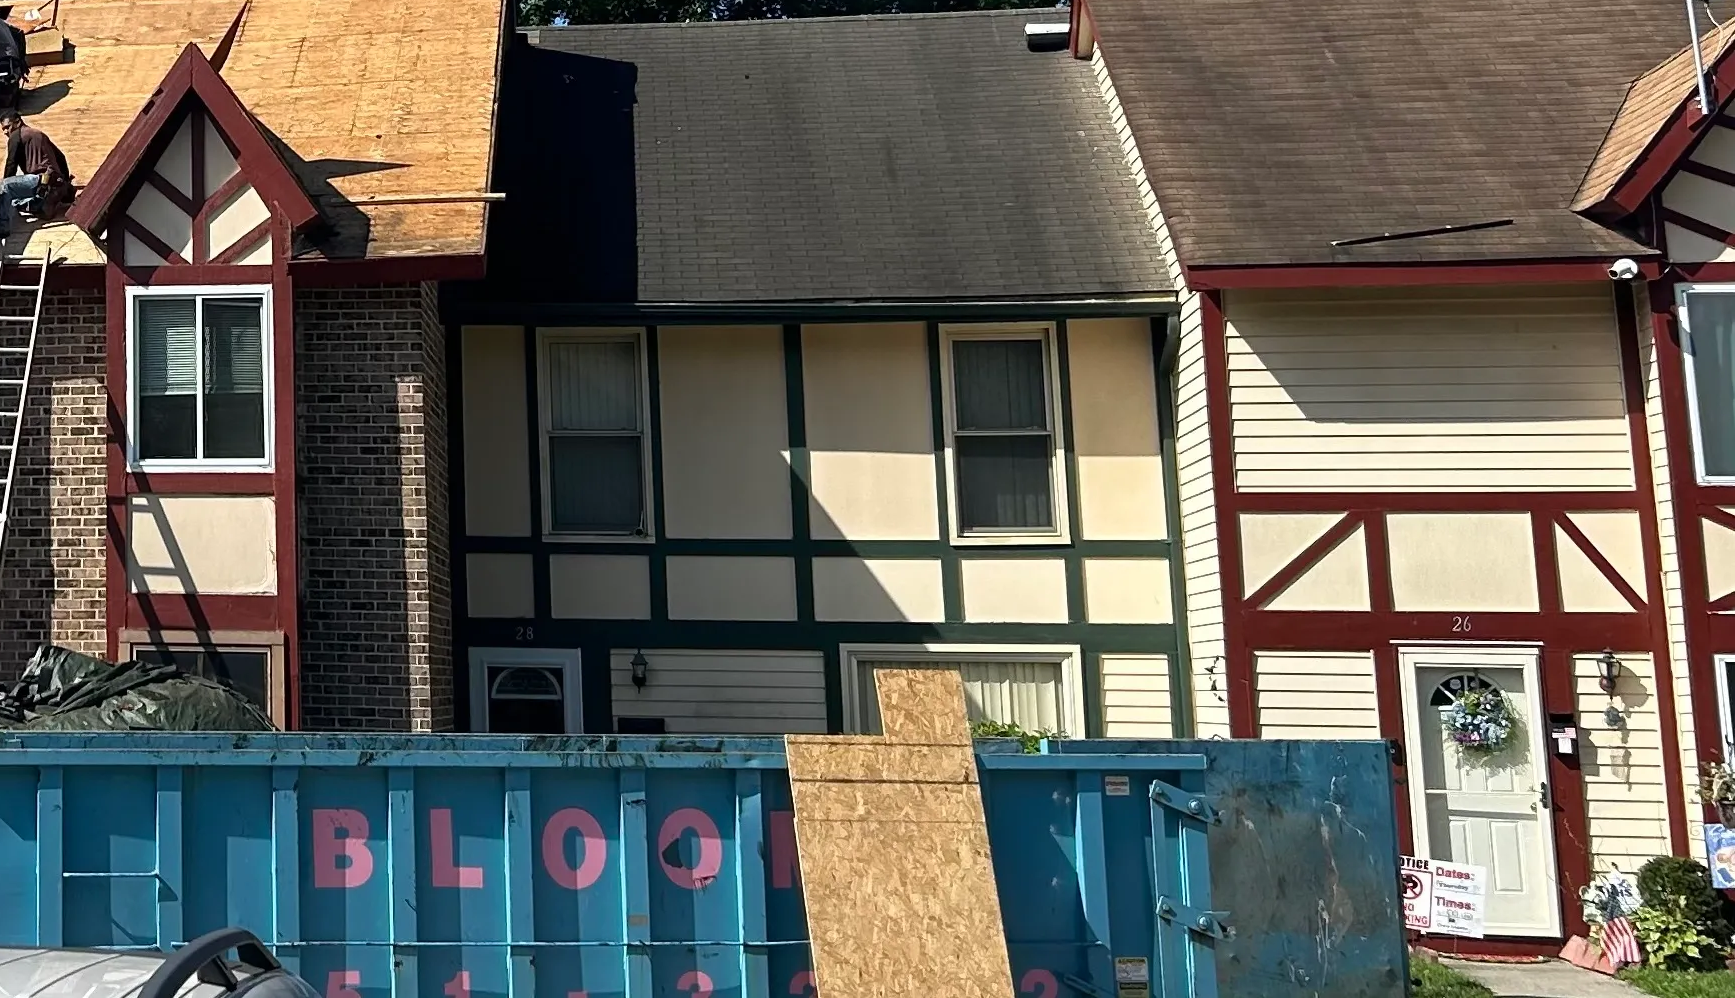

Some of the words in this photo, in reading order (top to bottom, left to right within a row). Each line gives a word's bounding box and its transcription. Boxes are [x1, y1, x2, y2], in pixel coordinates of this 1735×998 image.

[1451, 615, 1472, 632] 26
[515, 626, 534, 640] 28
[1399, 857, 1429, 870] OTICE
[1436, 867, 1475, 881] Dates:
[1434, 896, 1476, 911] Times:
[1403, 913, 1428, 925] KING
